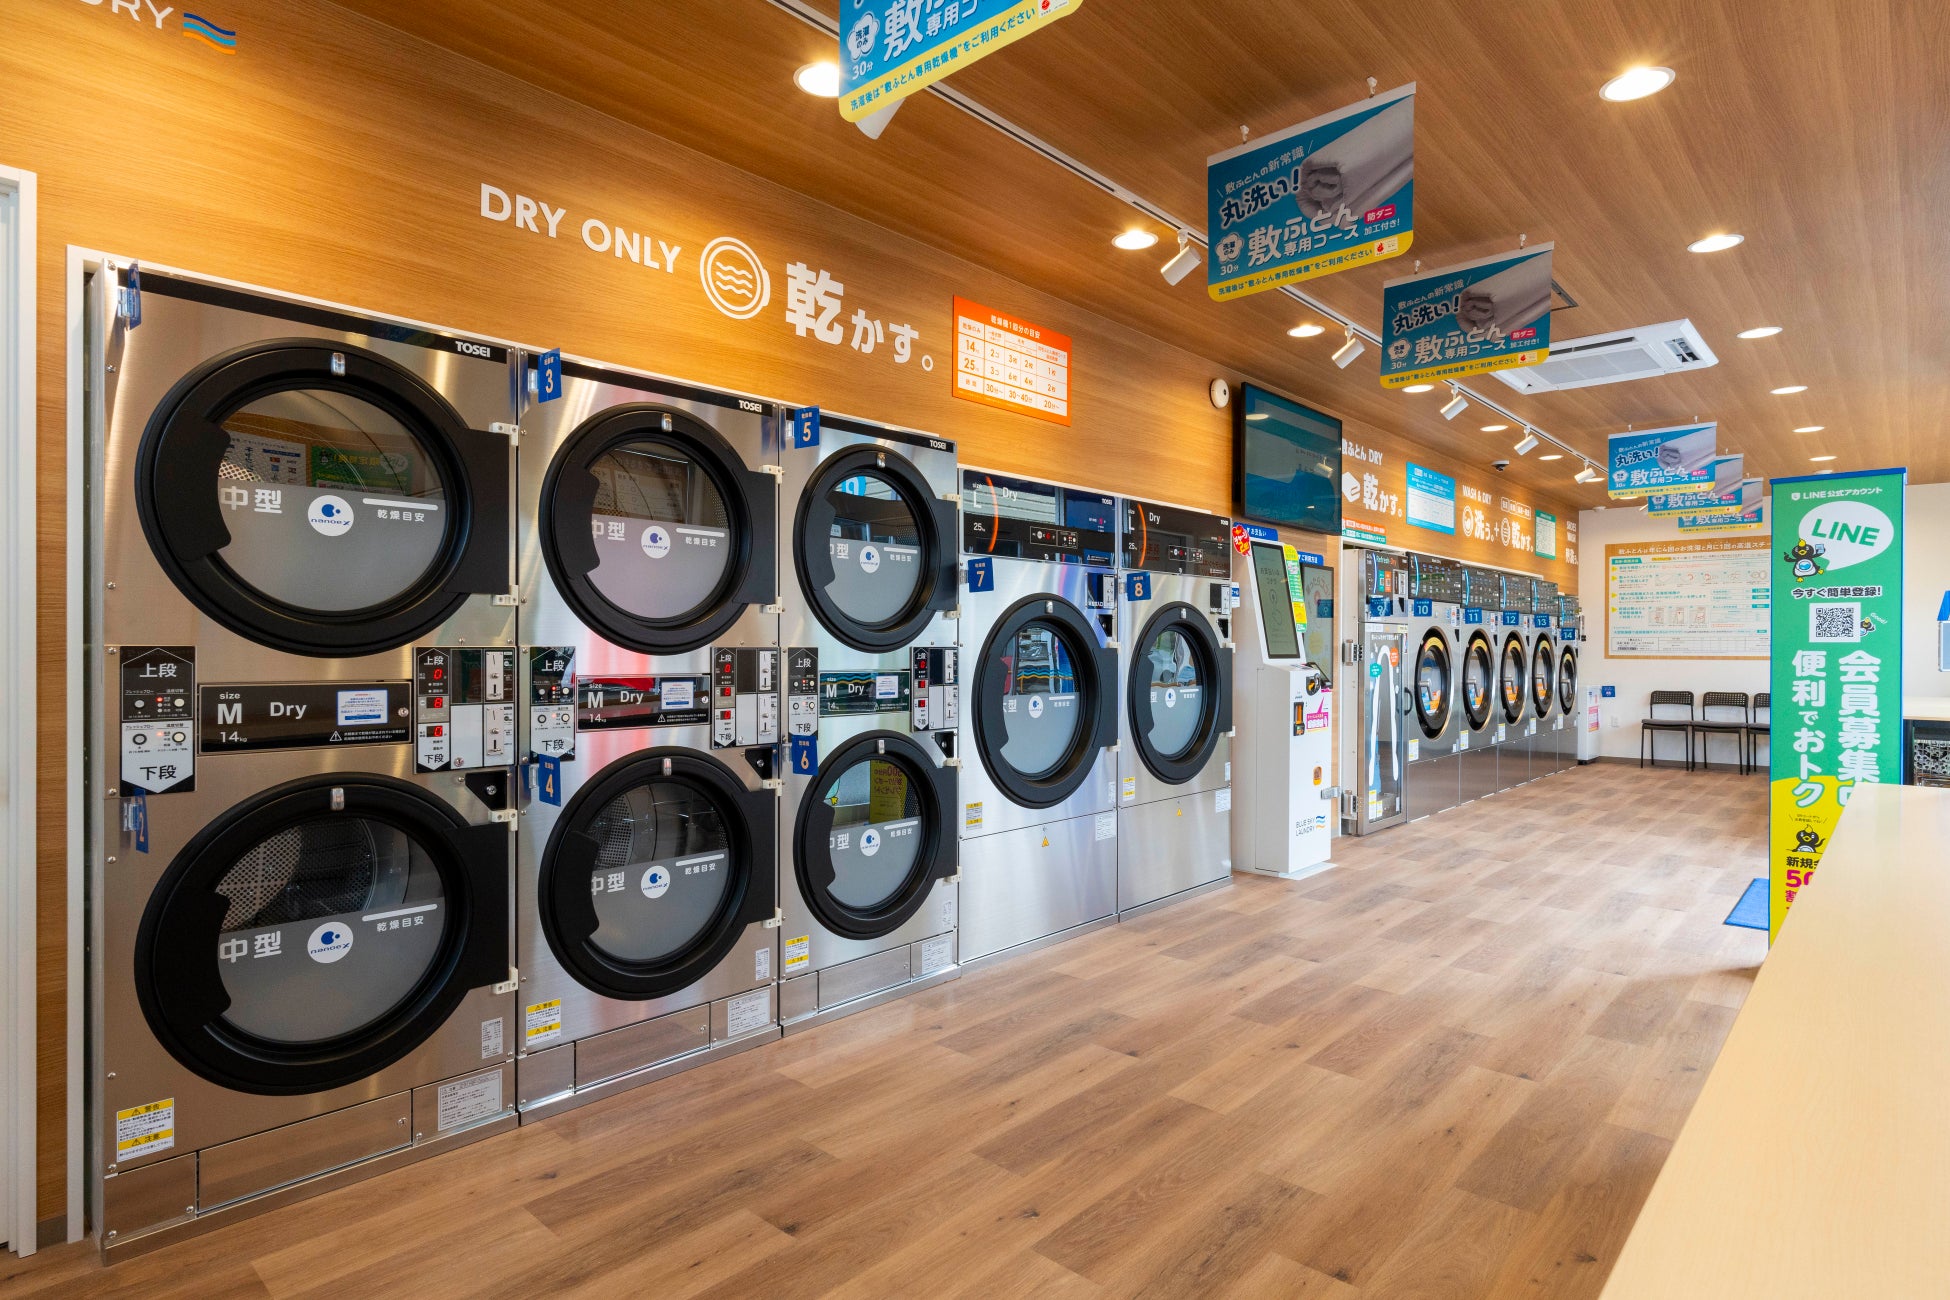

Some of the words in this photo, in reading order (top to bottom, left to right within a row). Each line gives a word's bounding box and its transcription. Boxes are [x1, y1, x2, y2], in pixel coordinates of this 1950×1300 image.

[852, 60, 874, 80] 30分
[1366, 207, 1393, 222] 防ダニ
[480, 183, 567, 239] DRY
[581, 218, 682, 274] ONLY
[1248, 203, 1359, 267] 敷ふとん
[1283, 226, 1359, 257] 専用コース
[784, 261, 935, 373] 乾かす。
[455, 341, 491, 358] TOSEI
[1414, 323, 1506, 365] 敷ふとん
[1444, 339, 1506, 360] 専用コース
[545, 368, 553, 393] 3
[738, 400, 762, 413] TOSEI
[802, 421, 812, 442] 5
[929, 439, 946, 450] TOSEI
[1368, 448, 1383, 465] DRY
[1630, 465, 1689, 486] 敷ふとん
[219, 485, 282, 515] 中型
[973, 491, 982, 508] L
[1002, 487, 1018, 501] Dry
[1462, 485, 1477, 500] WASH
[1482, 492, 1492, 505] DRY
[1803, 490, 1826, 499] LINE
[1827, 486, 1883, 498] 公式アカウント
[377, 509, 425, 523] 乾燥目安
[1149, 512, 1161, 524] Dry
[1811, 518, 1880, 547] LINE
[685, 536, 717, 547] 乾燥目安
[976, 570, 985, 587] 7
[1134, 582, 1143, 597] 8
[1417, 605, 1428, 615] 10
[1468, 612, 1478, 622] 11
[1506, 615, 1516, 624] 12
[1537, 618, 1547, 627] 13
[1563, 631, 1572, 639] 14
[424, 656, 444, 665] 上段
[718, 654, 732, 662] 上段
[795, 658, 811, 668] 上段
[139, 663, 177, 678] 上段
[541, 660, 565, 672] 上段
[433, 668, 443, 680] 0
[219, 692, 241, 700] size
[826, 684, 837, 698] M
[848, 683, 865, 695] Dry
[587, 691, 604, 709] M
[620, 690, 644, 705] Dry
[217, 703, 242, 725] M
[270, 702, 308, 720] Dry
[434, 726, 442, 737] 0
[795, 723, 811, 732] 下段
[1792, 650, 1827, 807] 便利でおトク
[718, 732, 732, 740] 下段
[541, 740, 565, 751] 下段
[424, 754, 444, 764] 下段
[801, 750, 810, 769] 6
[139, 765, 177, 781] 下段
[545, 775, 554, 798] 4
[684, 863, 716, 875] 乾燥目安
[376, 915, 424, 932] 乾燥目安
[220, 930, 282, 964] 中型
